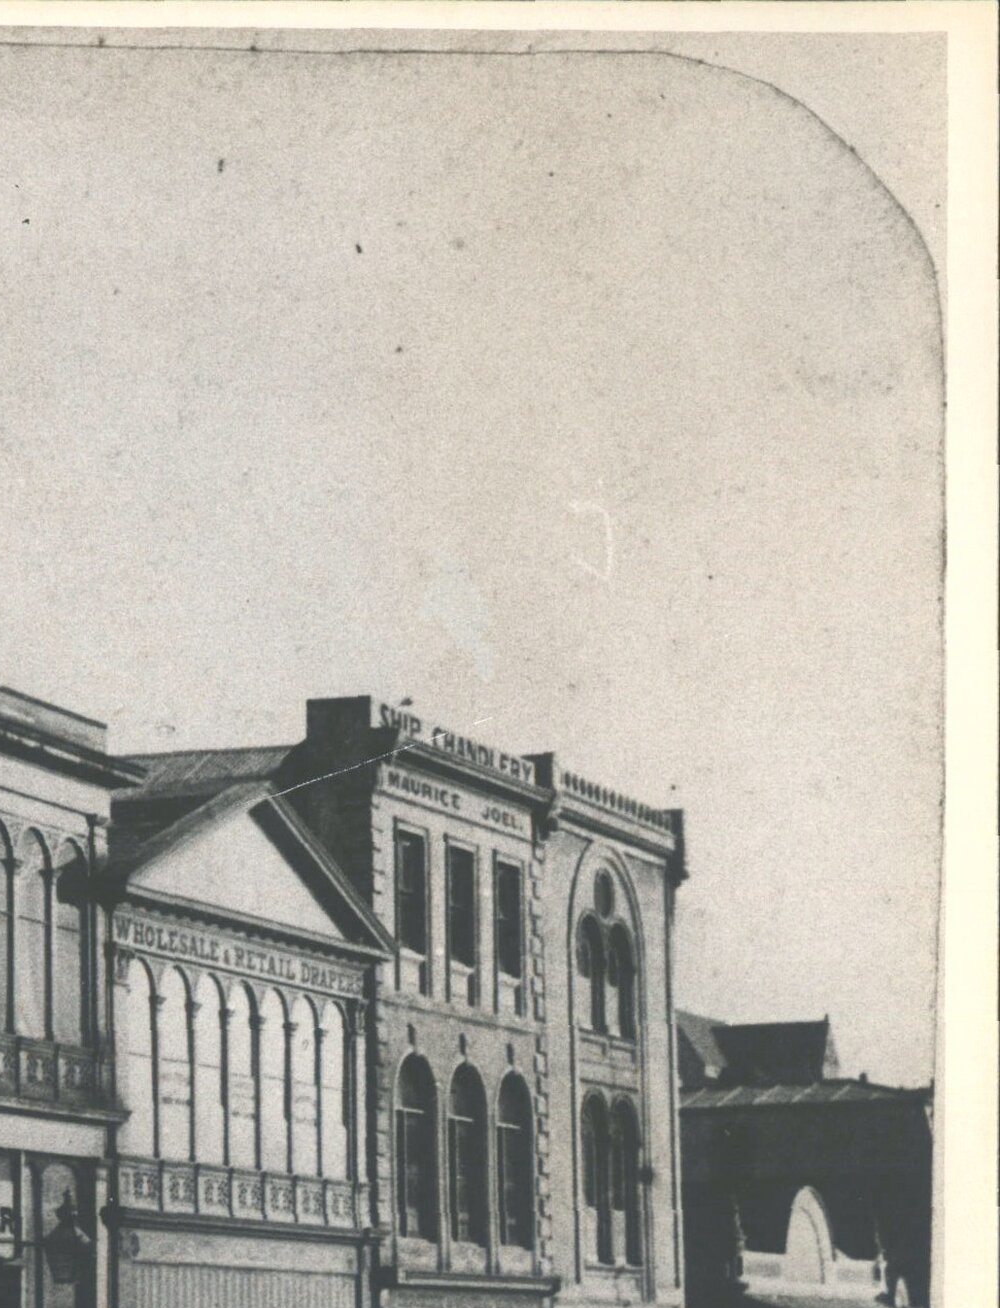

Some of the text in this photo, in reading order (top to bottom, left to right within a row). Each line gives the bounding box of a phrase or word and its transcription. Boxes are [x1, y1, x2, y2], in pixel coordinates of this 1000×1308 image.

[379, 702, 534, 783] SHIP CHANDLERY
[387, 770, 461, 811] MAURICE
[112, 915, 221, 962] WHOLESALE
[233, 946, 297, 981] RETAIL
[300, 962, 364, 994] DRAPERS
